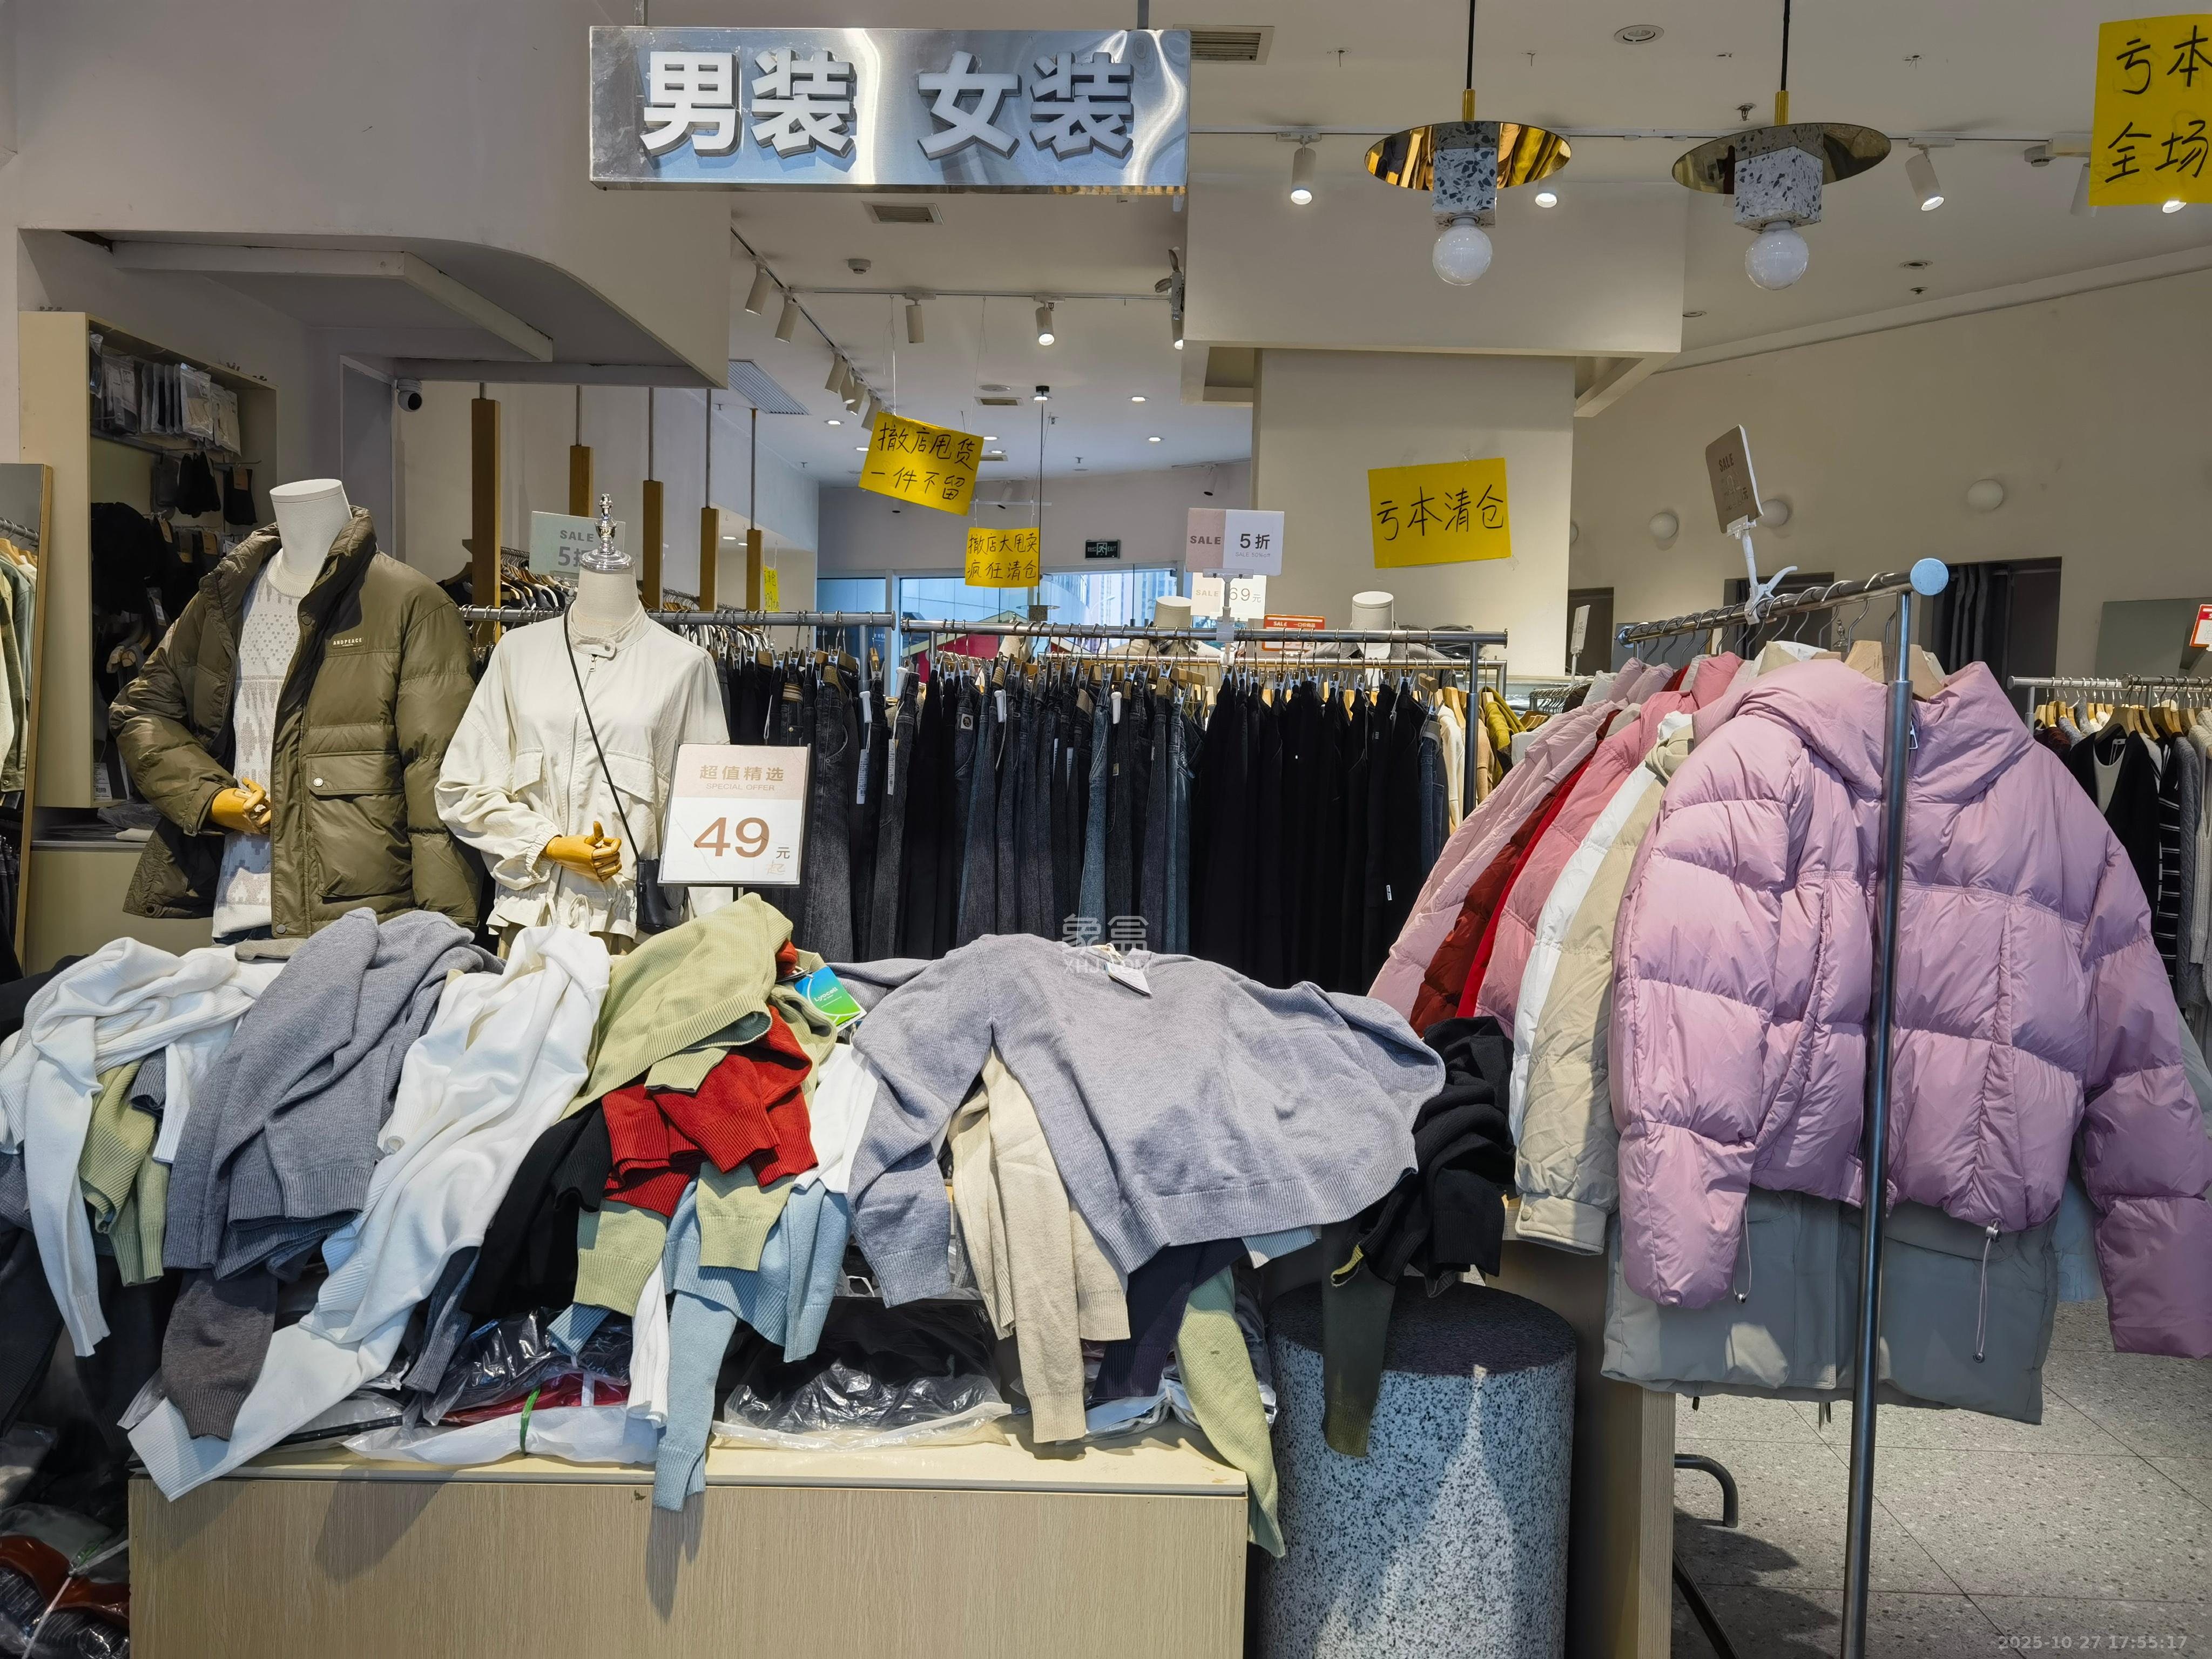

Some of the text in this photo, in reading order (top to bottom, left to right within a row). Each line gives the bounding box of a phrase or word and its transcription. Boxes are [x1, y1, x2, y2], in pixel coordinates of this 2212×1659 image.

[2116, 25, 2212, 95] 亏本
[639, 50, 1134, 160] 男装 女装
[2105, 120, 2208, 183] 全场
[876, 422, 975, 471] 撤店甩货
[1719, 453, 1734, 472] SALE
[871, 467, 966, 500] 一件不留
[1377, 484, 1503, 541] 亏本清仓
[559, 530, 594, 542] SALE
[1190, 535, 1222, 545] SALE
[1240, 533, 1270, 550] 5折
[967, 559, 1037, 581] 疯狂清仓
[699, 765, 784, 782] 超值精选
[814, 987, 839, 1002] Lyocell
